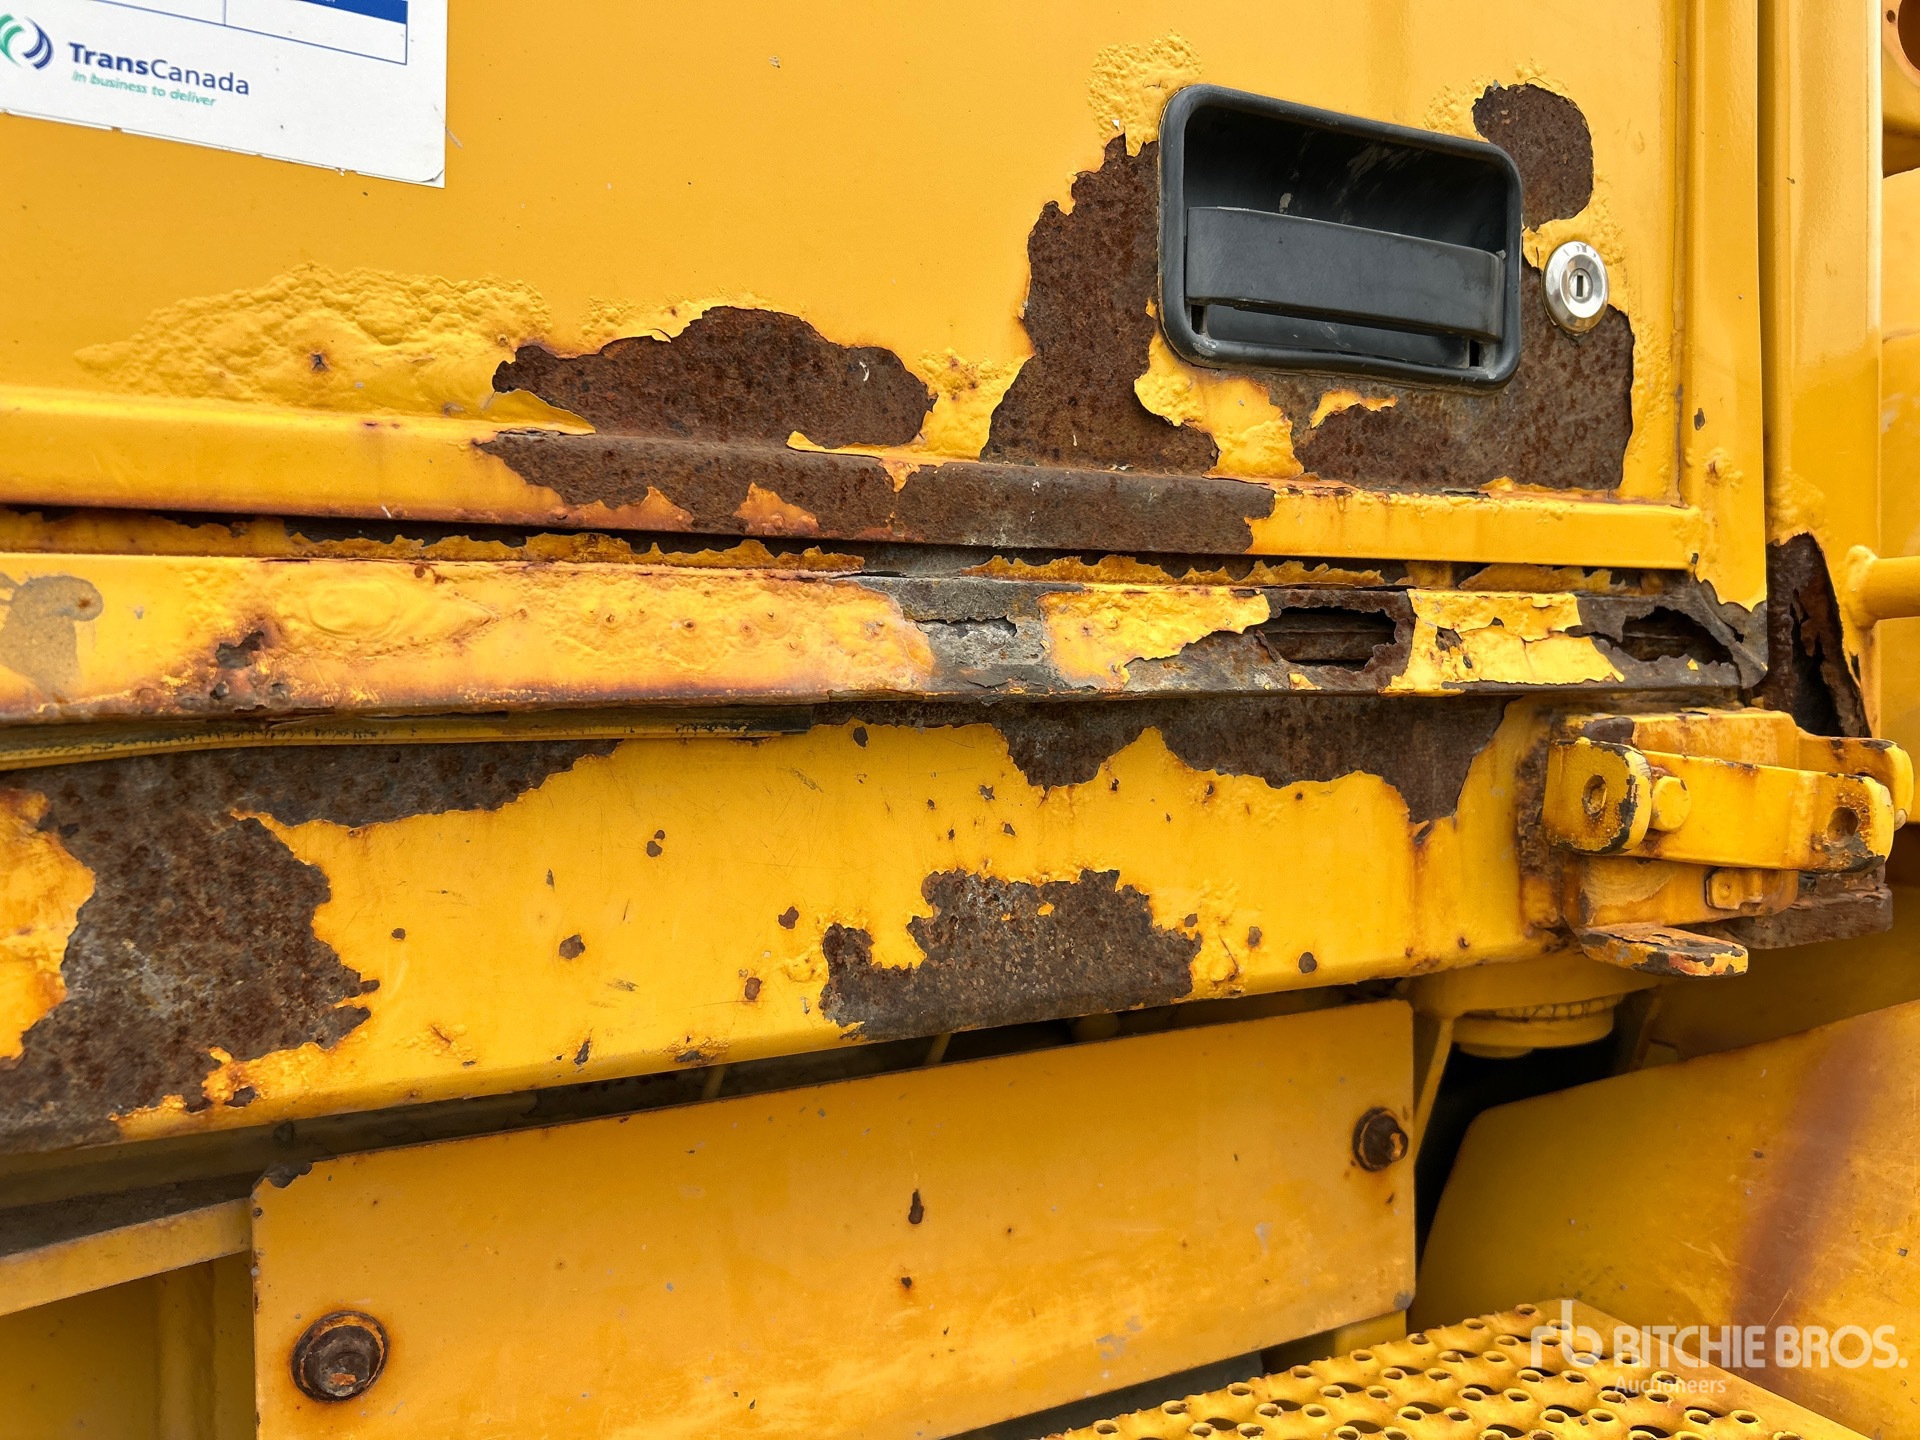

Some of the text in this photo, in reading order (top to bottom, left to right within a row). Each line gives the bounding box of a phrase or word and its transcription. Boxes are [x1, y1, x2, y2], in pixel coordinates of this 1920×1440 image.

[69, 42, 249, 95] TransCanada
[72, 70, 217, 107] In business to deliver
